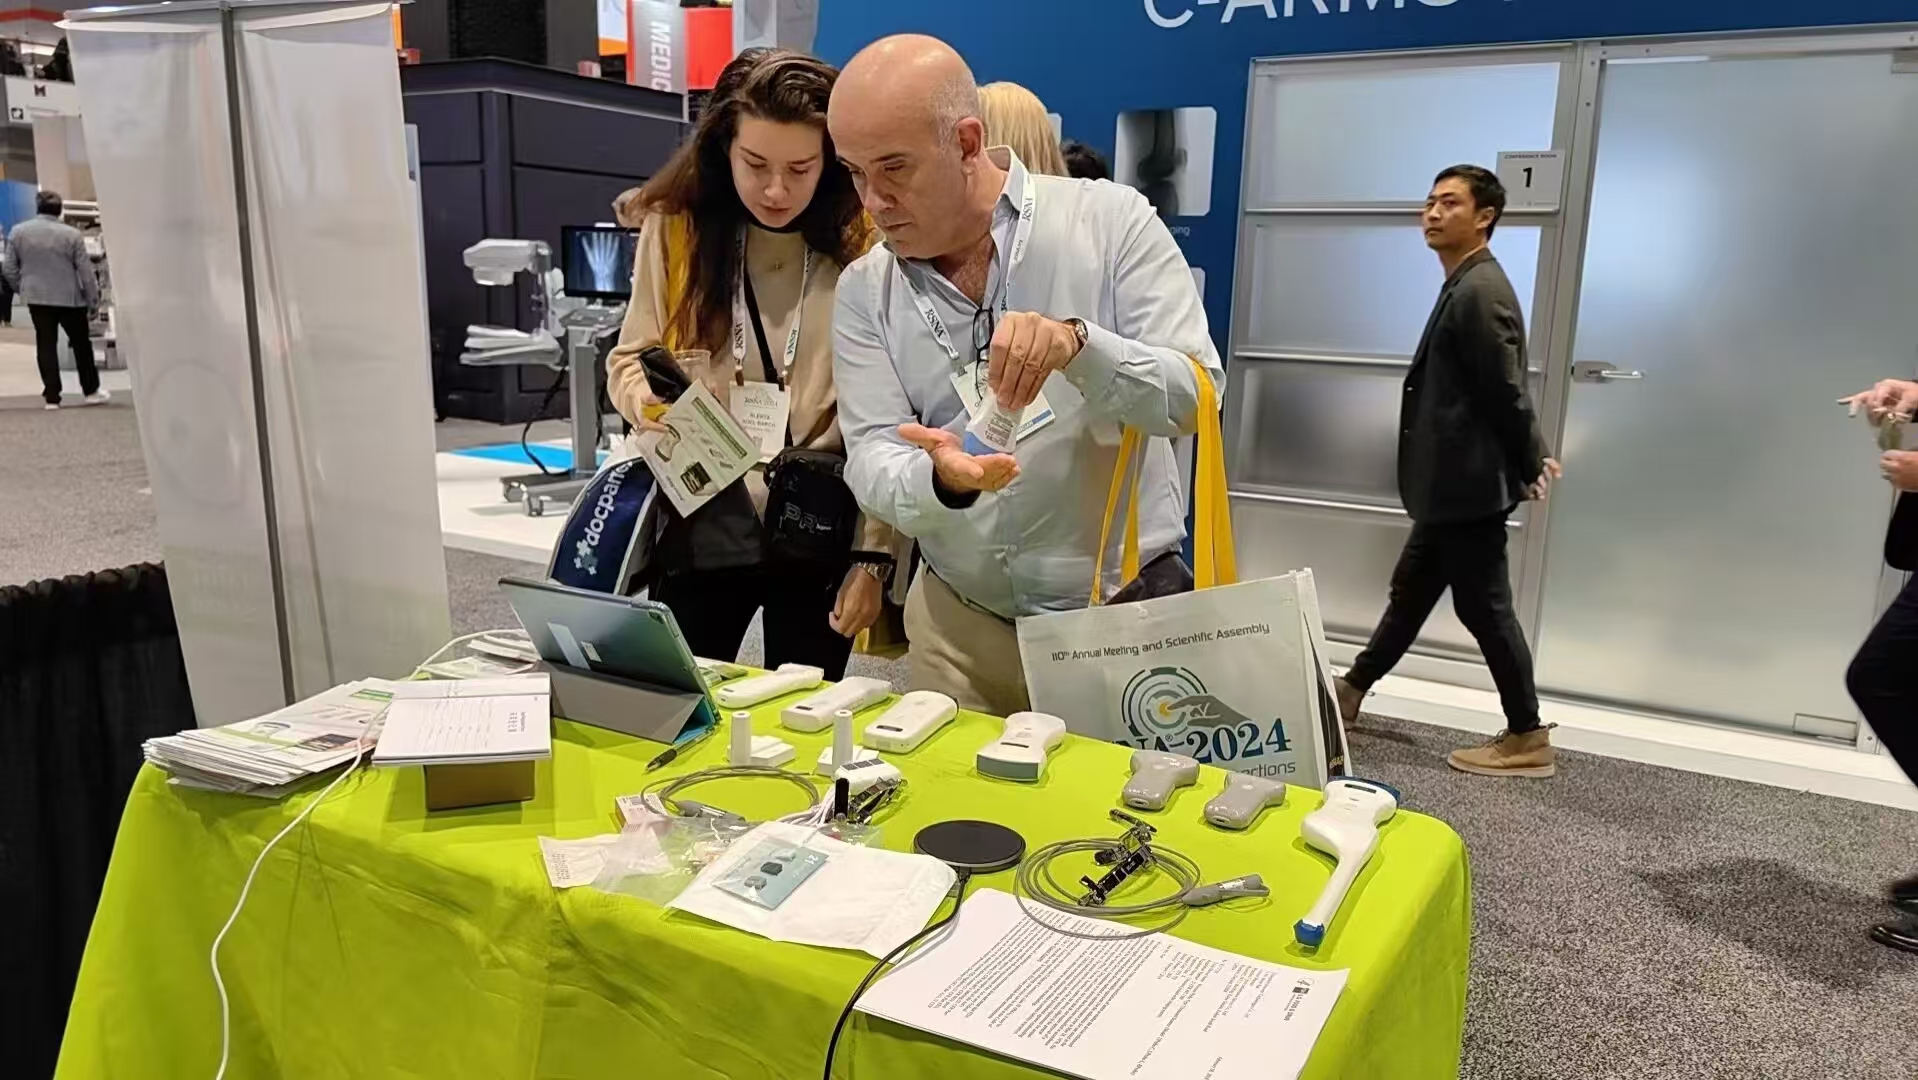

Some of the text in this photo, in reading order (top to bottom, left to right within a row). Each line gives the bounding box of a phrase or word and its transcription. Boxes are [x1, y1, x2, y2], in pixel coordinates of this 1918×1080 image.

[1523, 166, 1533, 188] 1
[733, 321, 743, 349] RSNA
[924, 307, 946, 338] RSNA
[1072, 647, 1102, 660] Annual
[1103, 645, 1140, 657] Meeting
[1142, 640, 1163, 652] and
[1165, 632, 1214, 649] Scientific
[1216, 623, 1270, 640] Assembly
